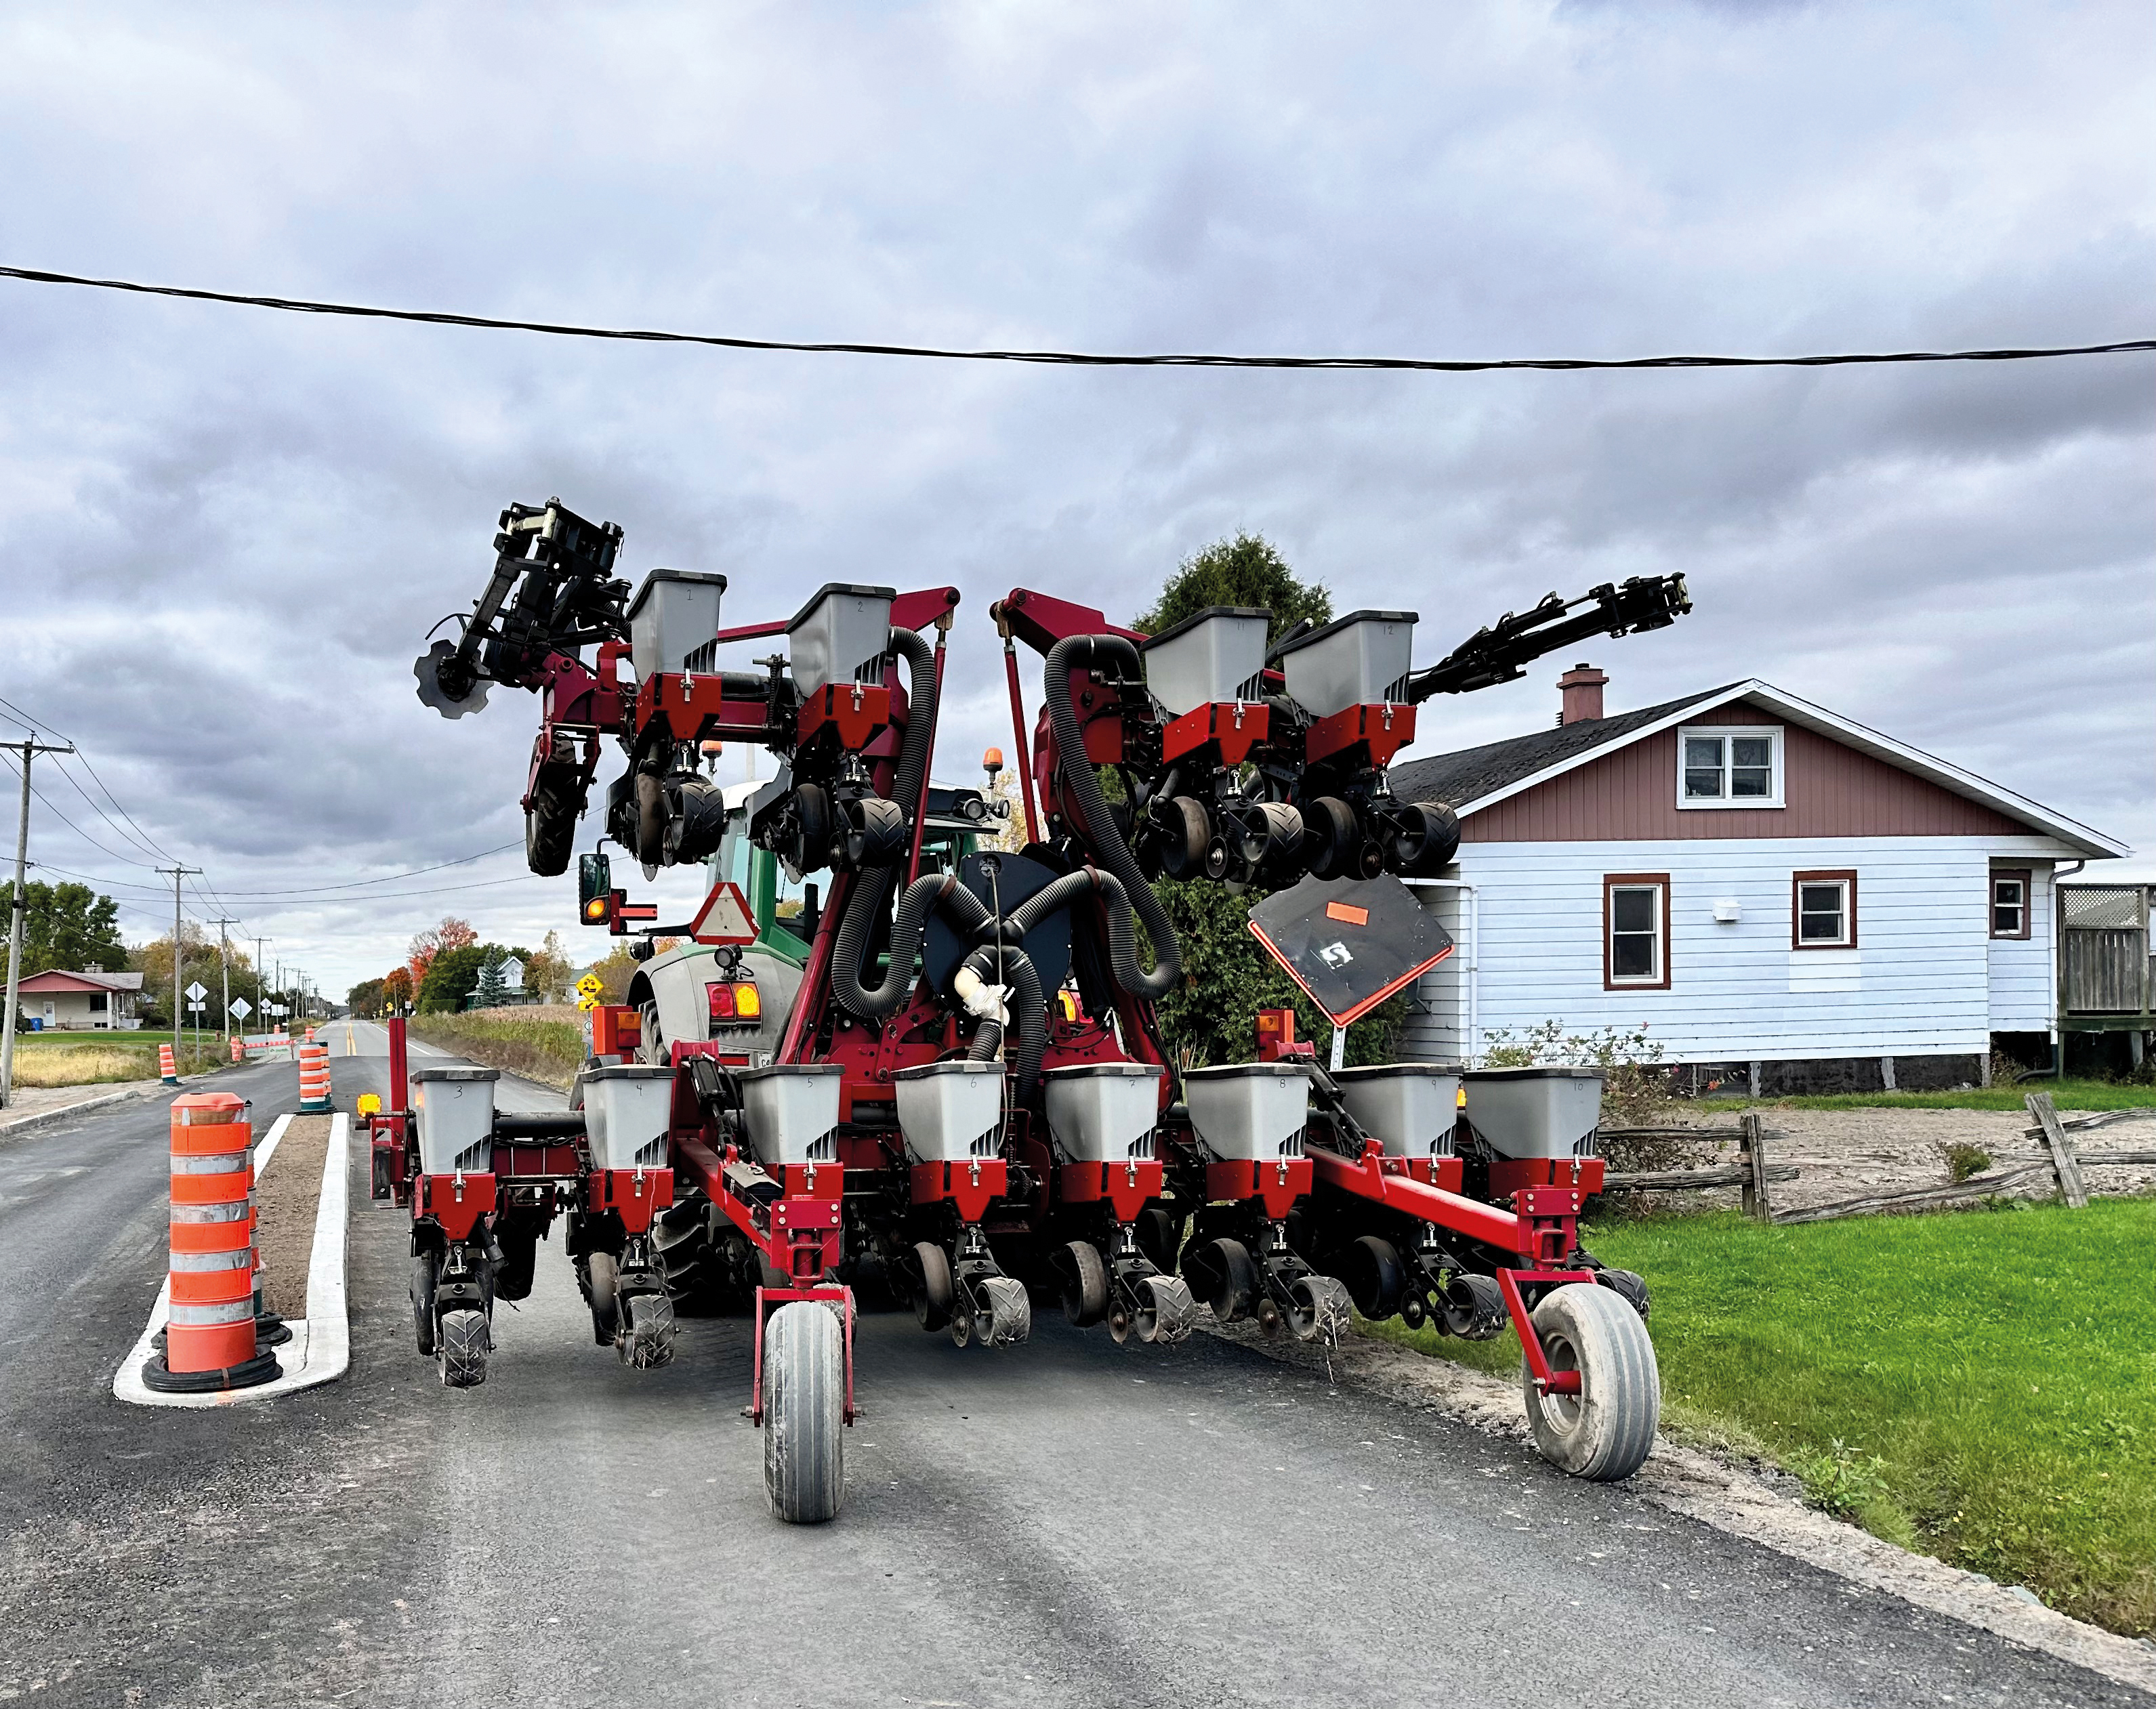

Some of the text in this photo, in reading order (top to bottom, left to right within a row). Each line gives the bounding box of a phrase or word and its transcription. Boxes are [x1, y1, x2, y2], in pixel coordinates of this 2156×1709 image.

[686, 589, 694, 601] 1
[857, 601, 864, 612] 2
[1237, 621, 1245, 631] 11
[1383, 625, 1394, 635] 12
[808, 1077, 814, 1088] 5
[970, 1076, 977, 1089] 6
[1129, 1079, 1136, 1089] 7
[1279, 1078, 1286, 1089] 8
[1431, 1079, 1436, 1091] 9
[1574, 1082, 1583, 1091] 10
[453, 1085, 463, 1099] 3
[636, 1084, 642, 1097] 4
